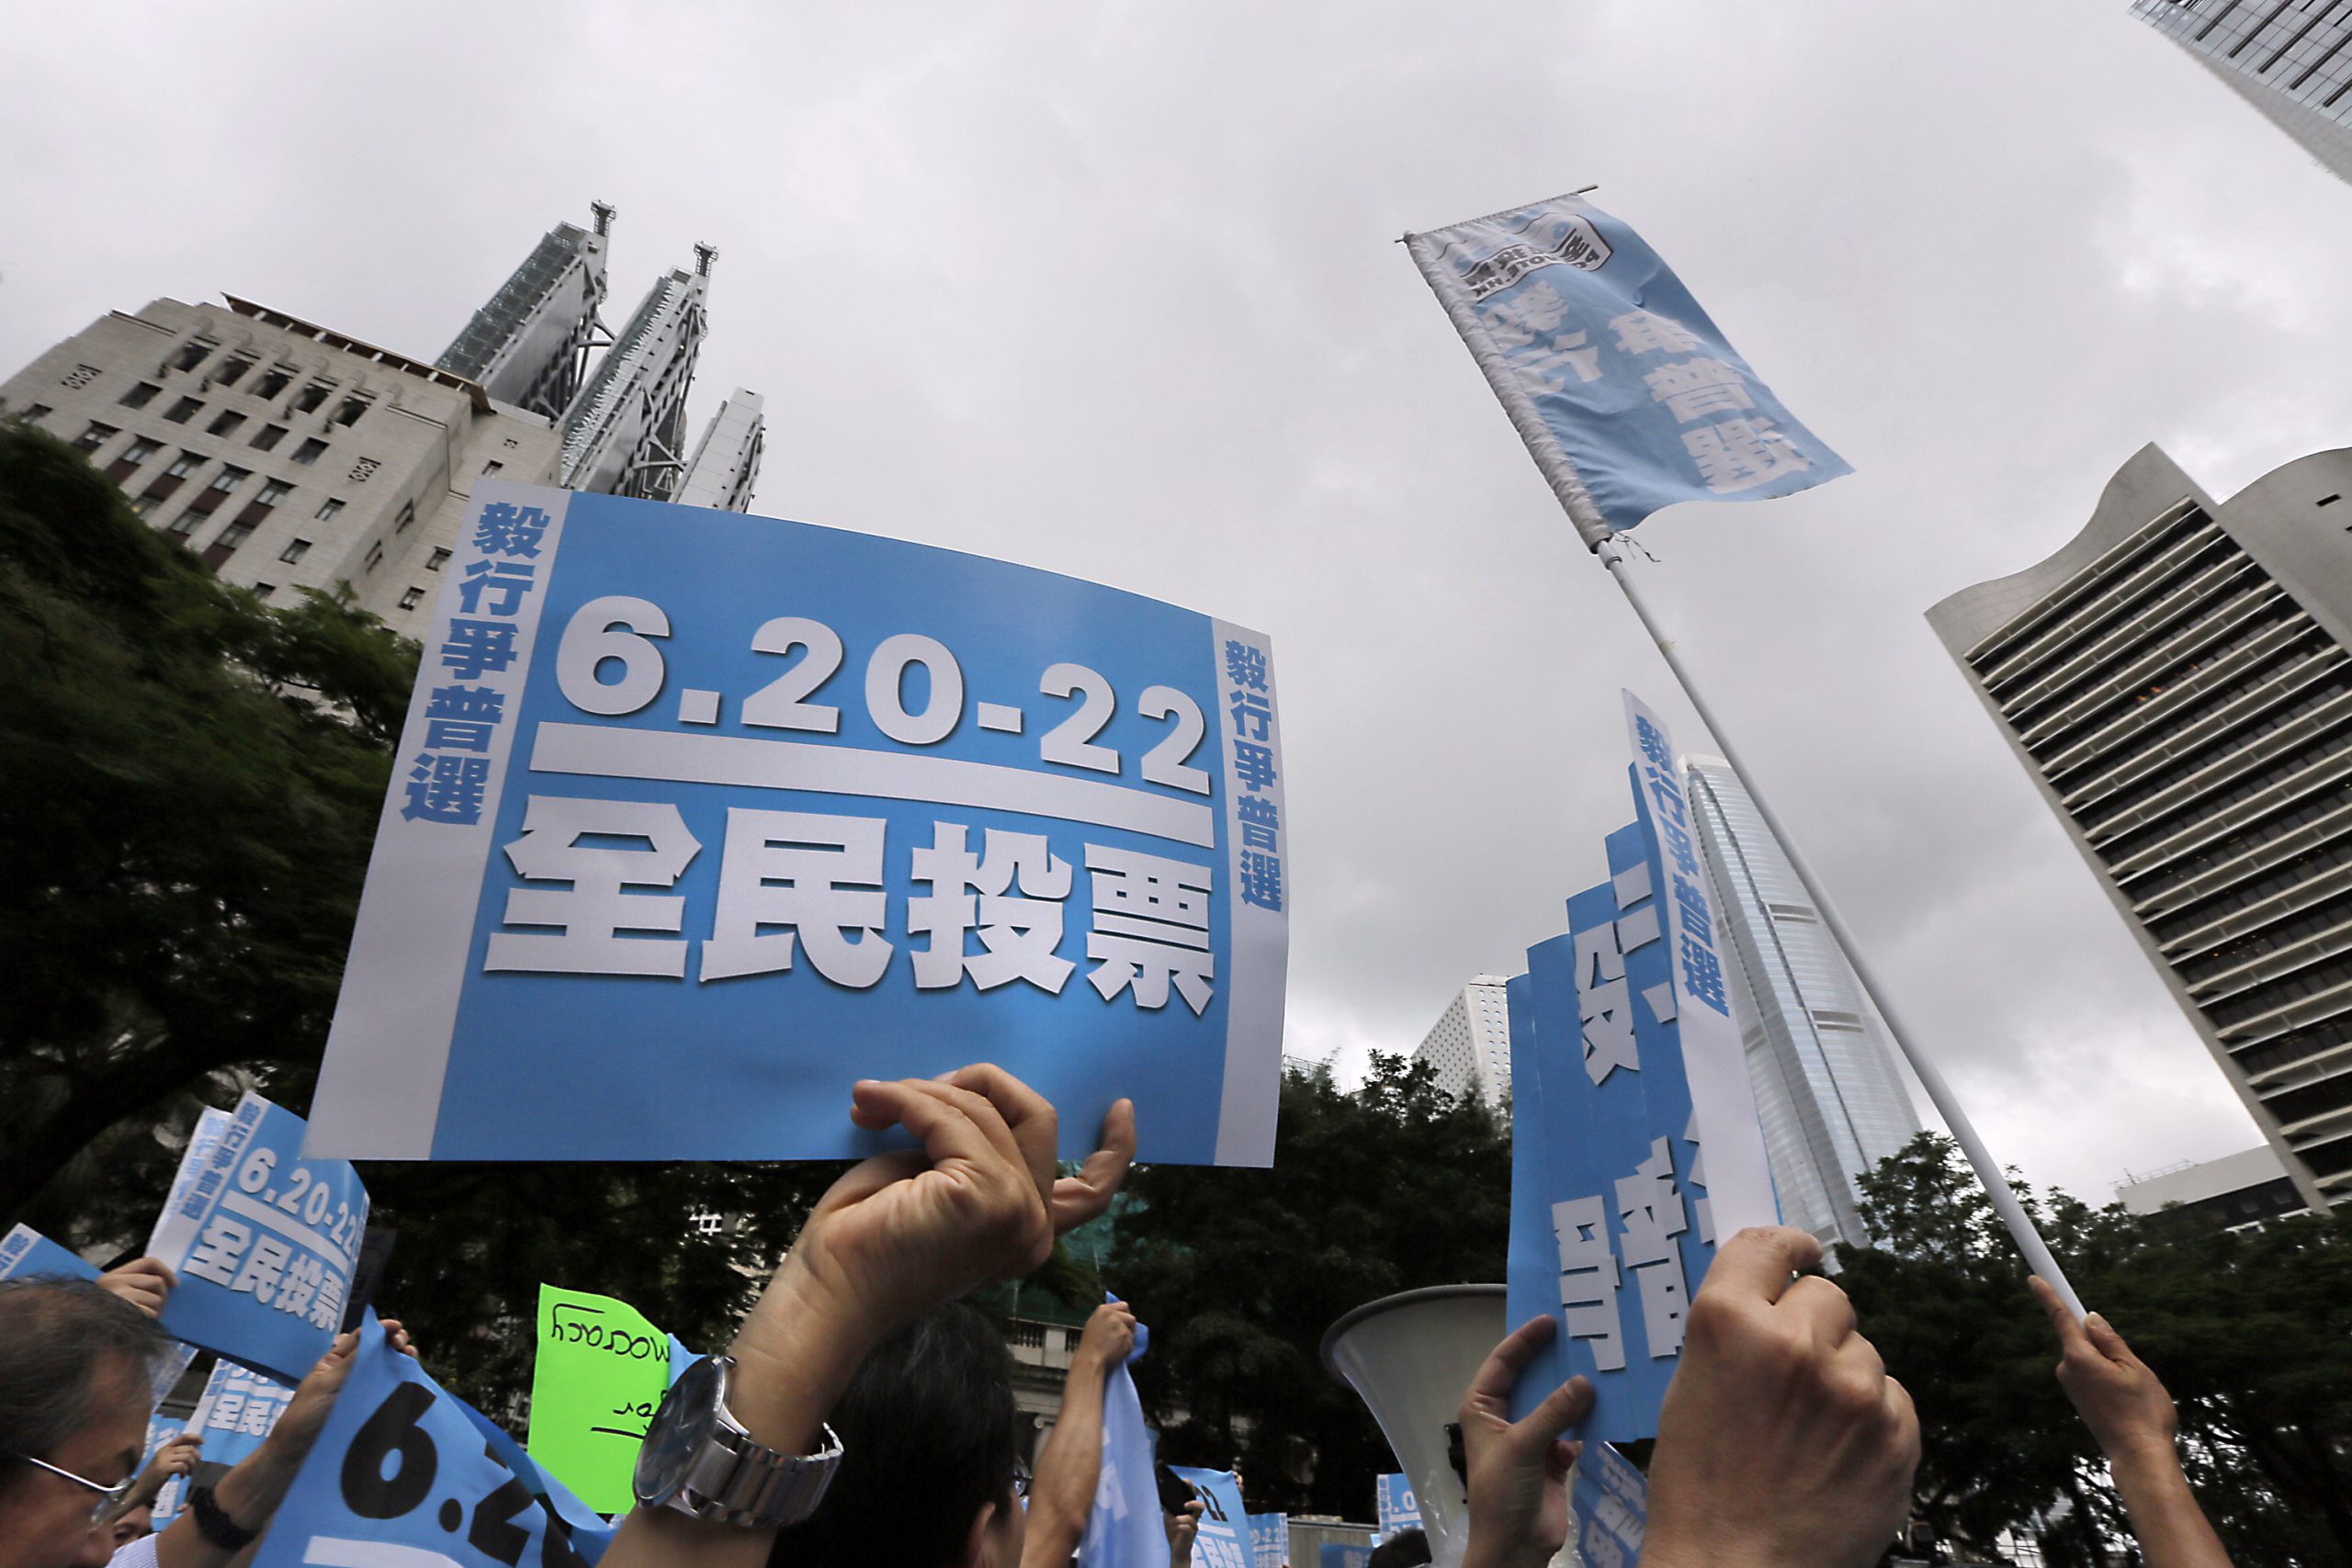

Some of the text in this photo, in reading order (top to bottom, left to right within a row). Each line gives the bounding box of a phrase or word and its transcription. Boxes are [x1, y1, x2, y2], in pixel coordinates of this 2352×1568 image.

[404, 502, 550, 827] 毅行爭普選
[554, 595, 1212, 795] 6.20-22
[1218, 639, 1283, 913] 毅行爭普選
[1635, 714, 1730, 1018] 毅行爭普選
[483, 795, 1216, 1016] 全民投票
[183, 1214, 345, 1332] 全民投票
[238, 1147, 358, 1258] 6.20-22
